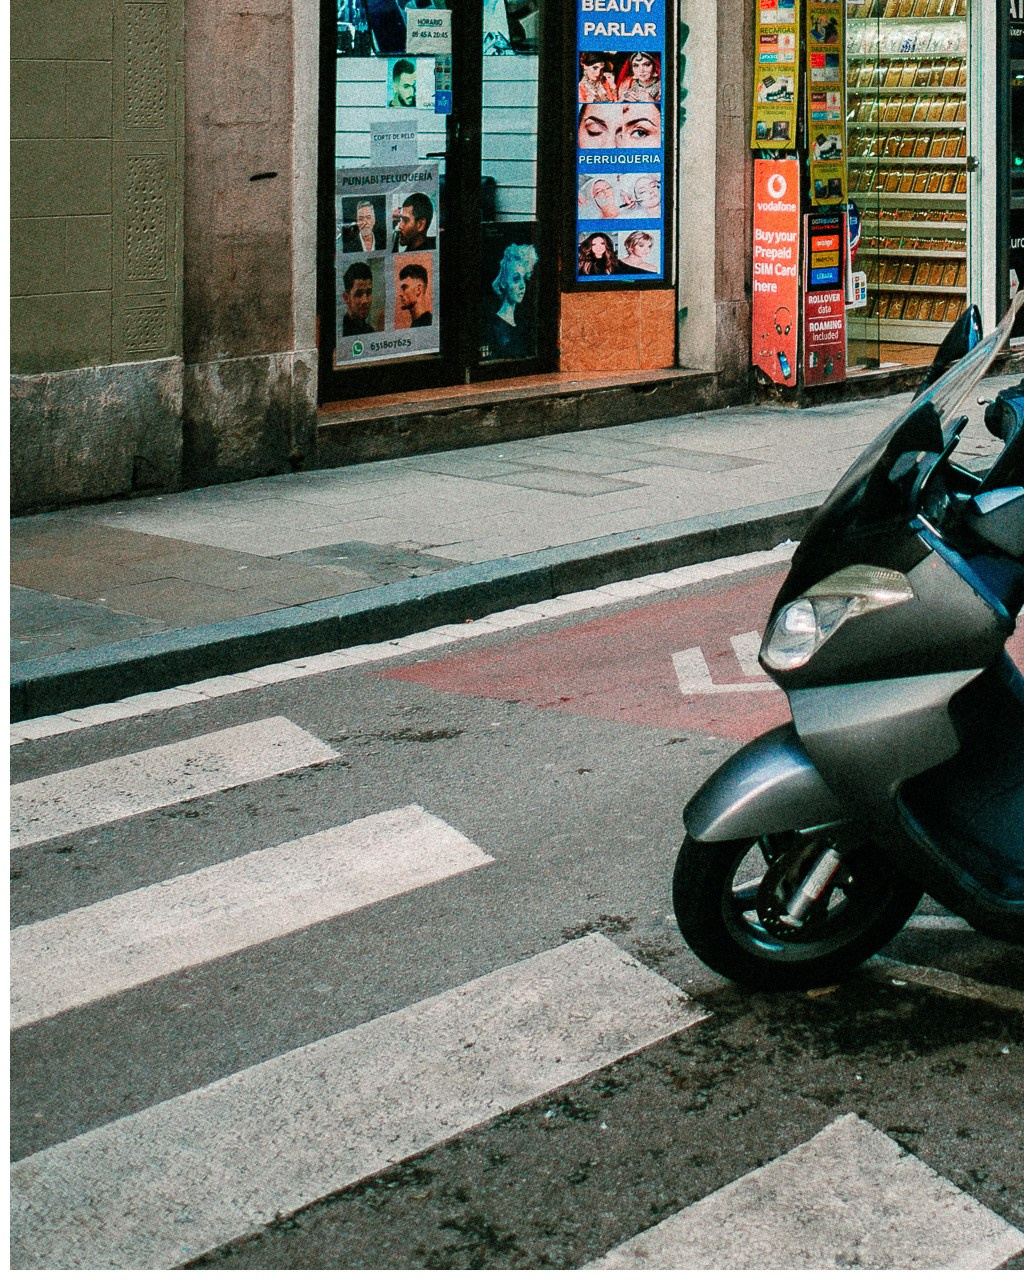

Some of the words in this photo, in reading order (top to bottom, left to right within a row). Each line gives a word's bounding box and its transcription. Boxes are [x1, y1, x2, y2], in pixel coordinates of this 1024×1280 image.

[584, 22, 657, 36] PARLAR
[579, 154, 660, 164] PERRUQUERIA
[342, 174, 379, 186] PUNJABI
[757, 201, 797, 212] vodafone
[755, 228, 775, 244] Buy
[775, 232, 797, 244] your
[755, 245, 792, 261] Prepaid
[754, 262, 774, 275] SIM
[774, 263, 797, 277] Card
[754, 280, 778, 292] here
[808, 293, 841, 304] ROLLOVER
[817, 305, 832, 314] data
[809, 319, 842, 332] ROAMING
[812, 331, 839, 341] included
[370, 338, 412, 351] 631807625
